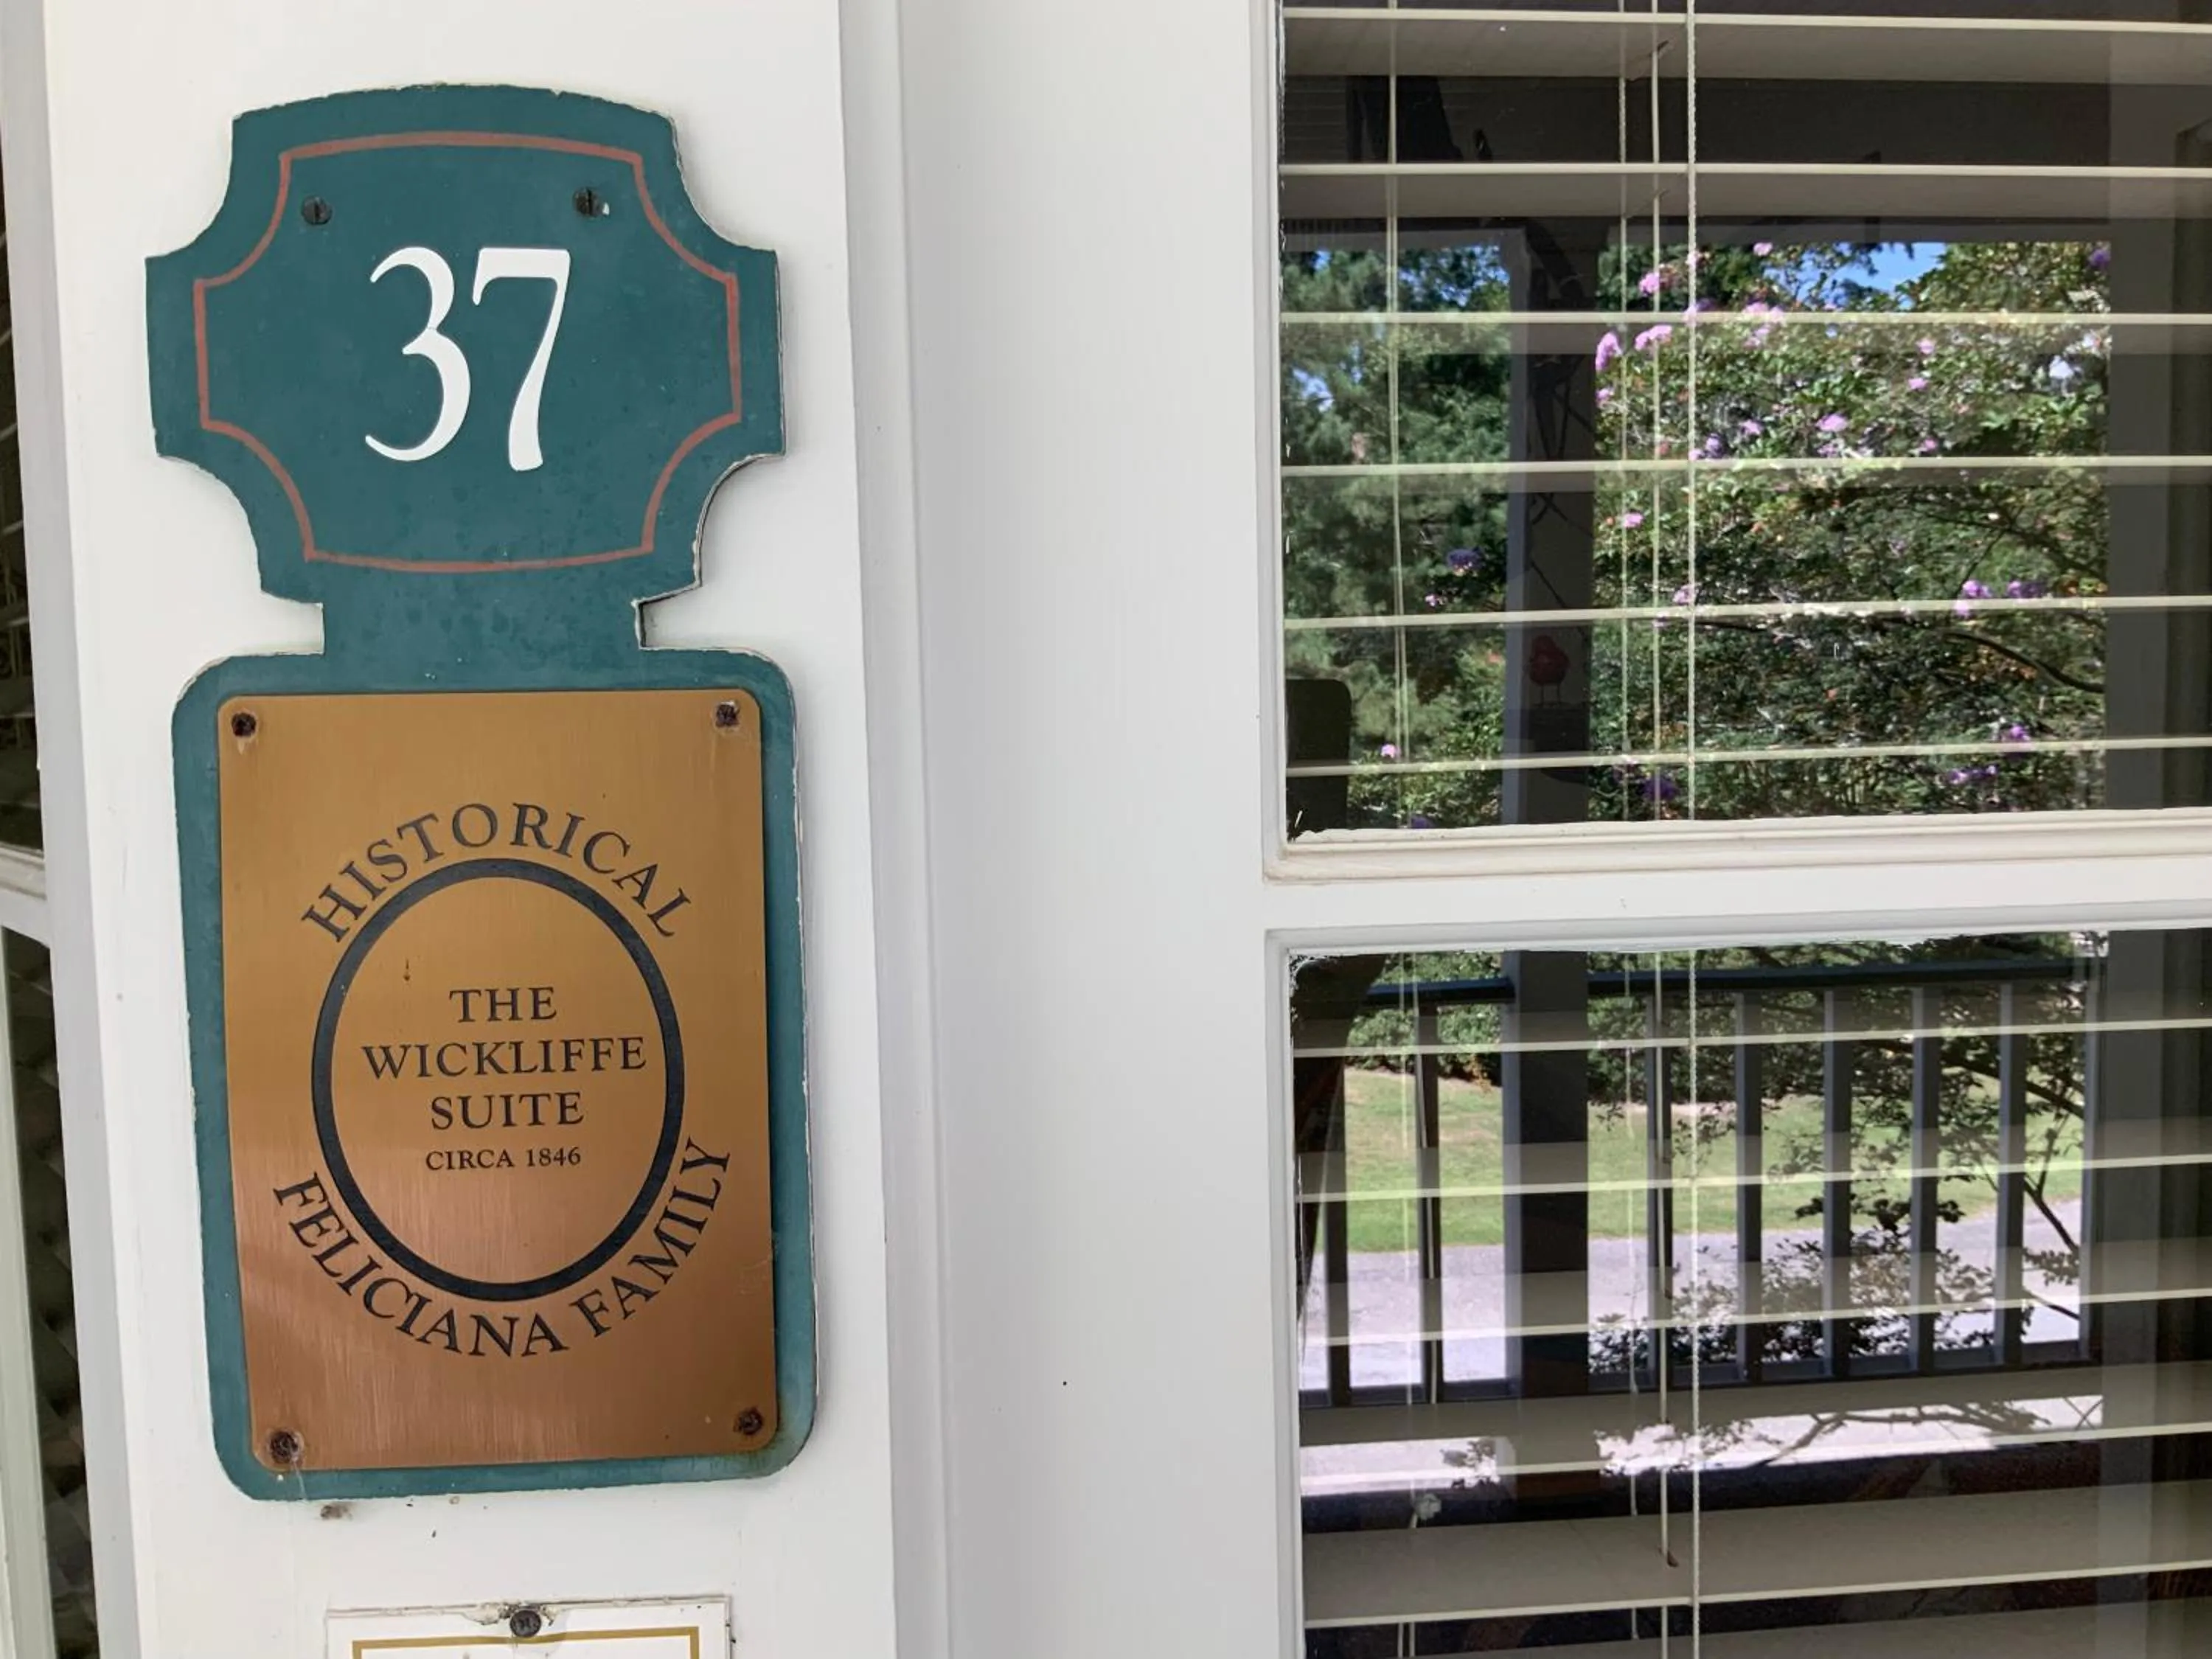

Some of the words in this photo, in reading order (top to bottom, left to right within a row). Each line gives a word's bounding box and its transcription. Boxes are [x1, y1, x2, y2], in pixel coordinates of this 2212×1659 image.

[362, 246, 571, 472] 37
[302, 802, 692, 942] HISTORICAL
[449, 986, 557, 1024] THE
[363, 1036, 647, 1079] WICKLIFFE
[430, 1091, 585, 1131] SUITE
[425, 1149, 515, 1173] CIRCA
[525, 1147, 582, 1170] 1846
[273, 1172, 569, 1360] FELICIANA
[569, 1135, 732, 1338] FAMILY
